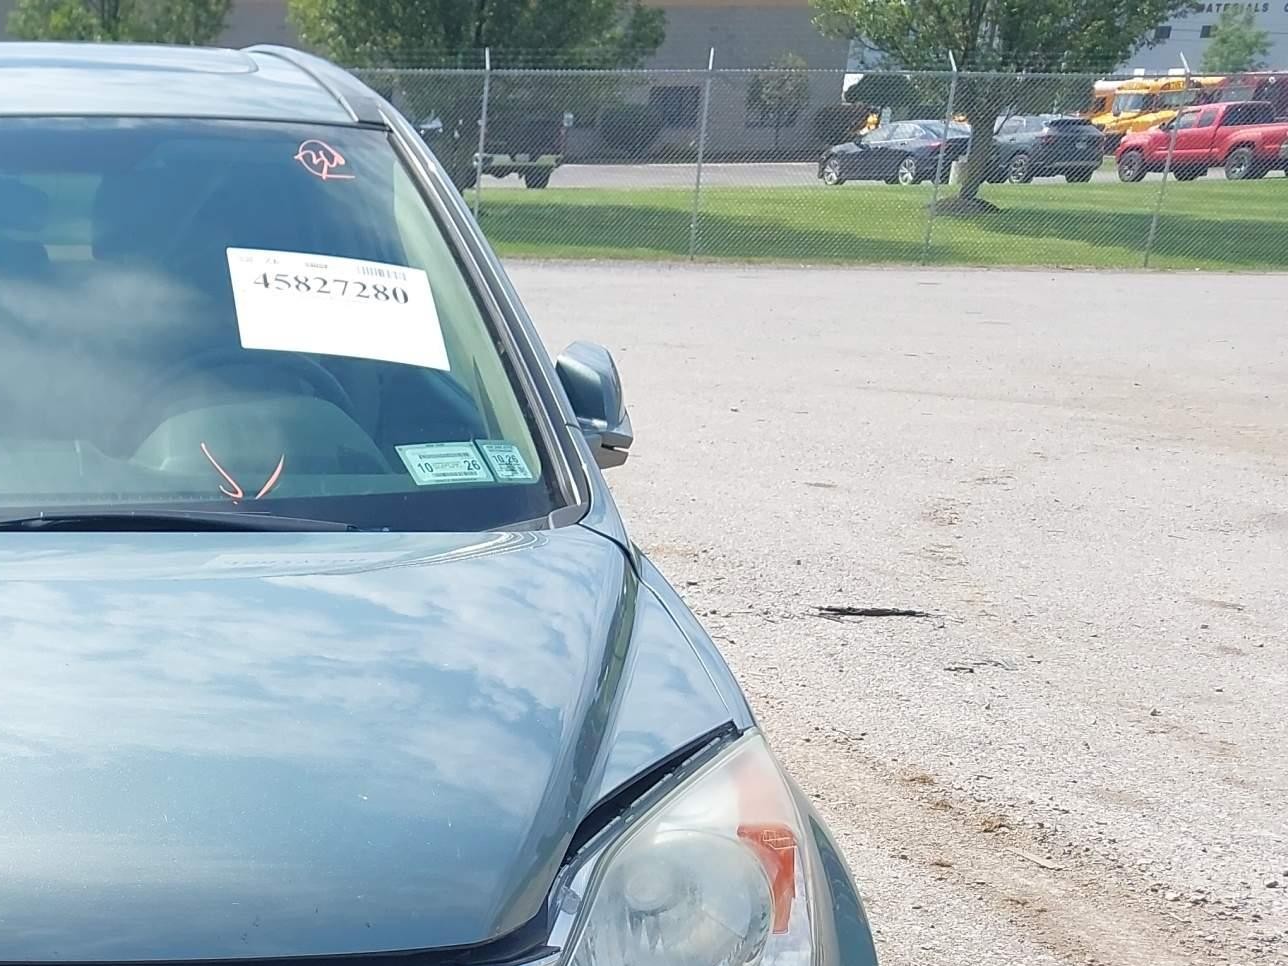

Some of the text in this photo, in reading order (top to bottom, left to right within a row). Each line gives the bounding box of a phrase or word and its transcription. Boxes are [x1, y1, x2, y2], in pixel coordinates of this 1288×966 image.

[1194, 3, 1270, 13] ATEALS
[253, 271, 409, 304] 45827280
[417, 462, 434, 474] 10
[463, 459, 481, 472] 26
